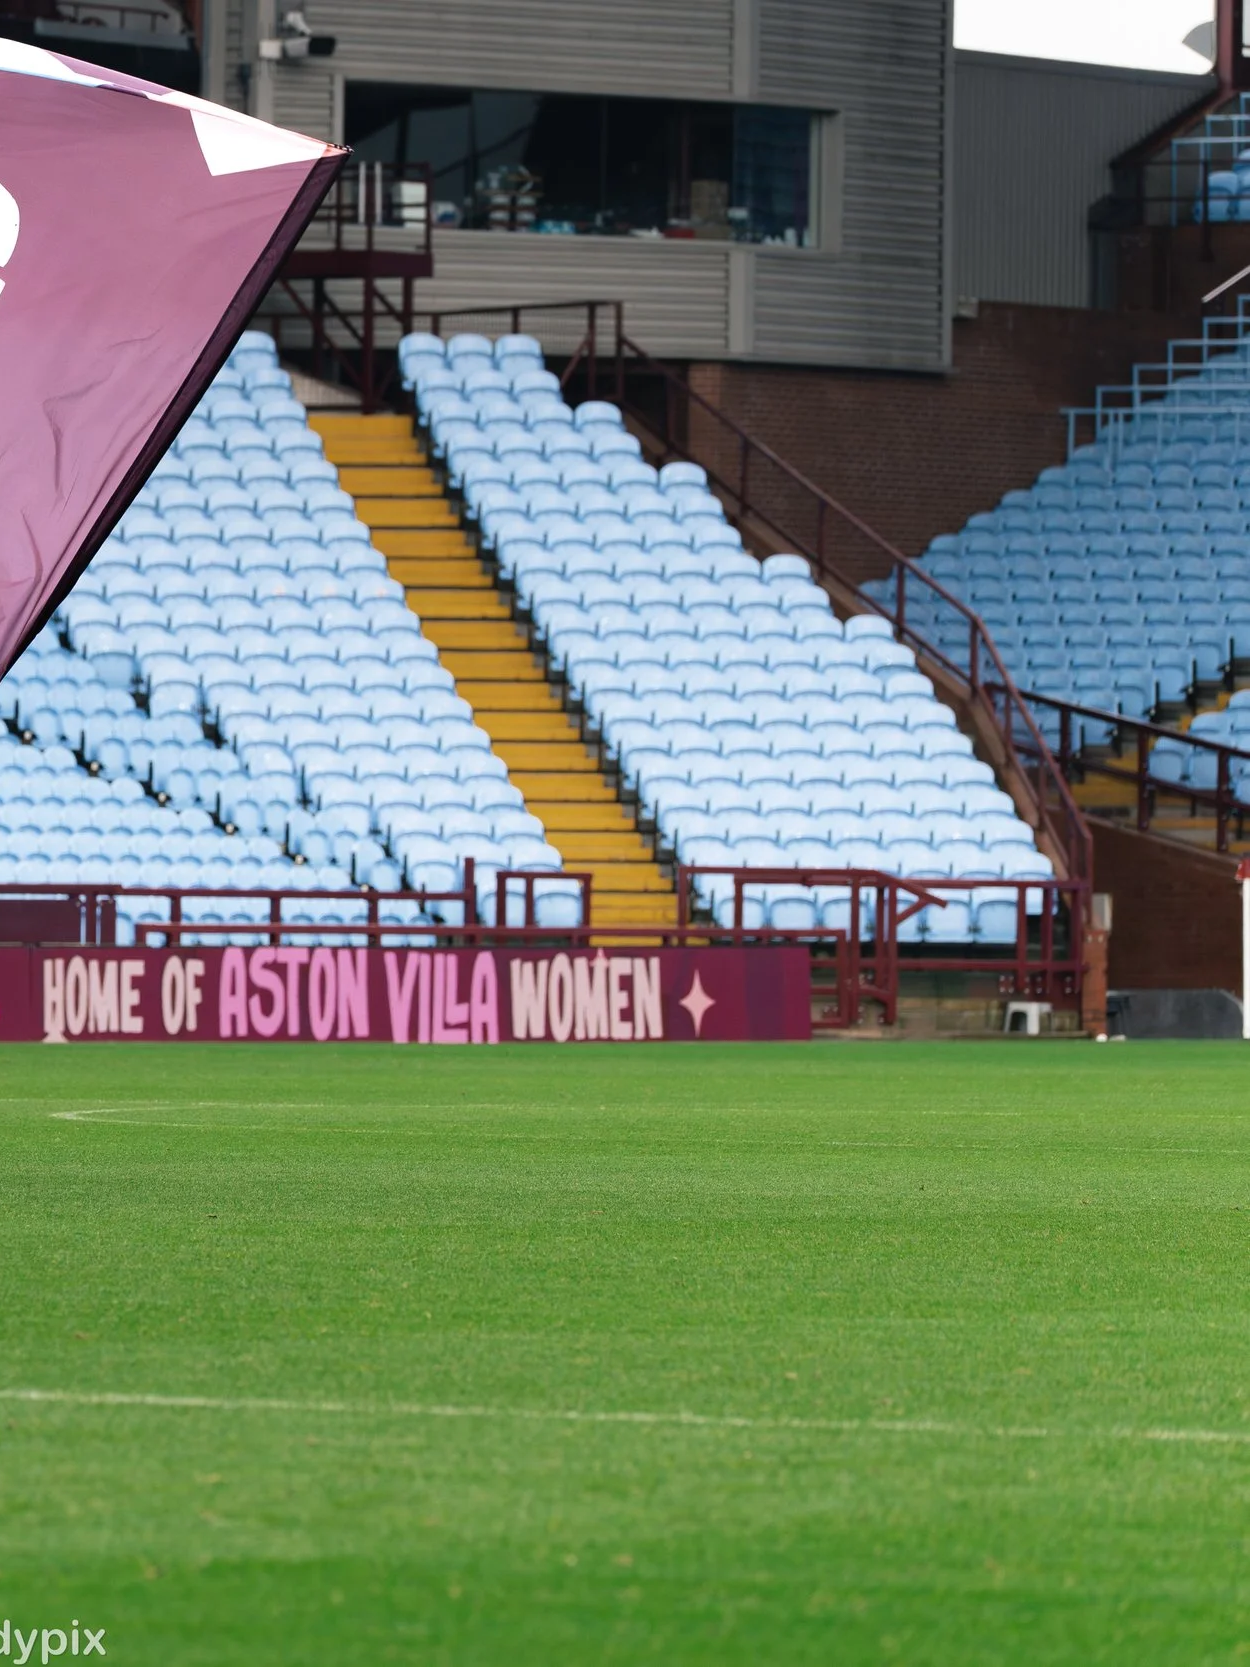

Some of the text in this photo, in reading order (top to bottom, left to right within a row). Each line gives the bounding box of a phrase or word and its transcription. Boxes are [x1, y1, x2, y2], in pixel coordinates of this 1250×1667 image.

[42, 947, 663, 1043] HOME OF ASTON VILLA WOMEN
